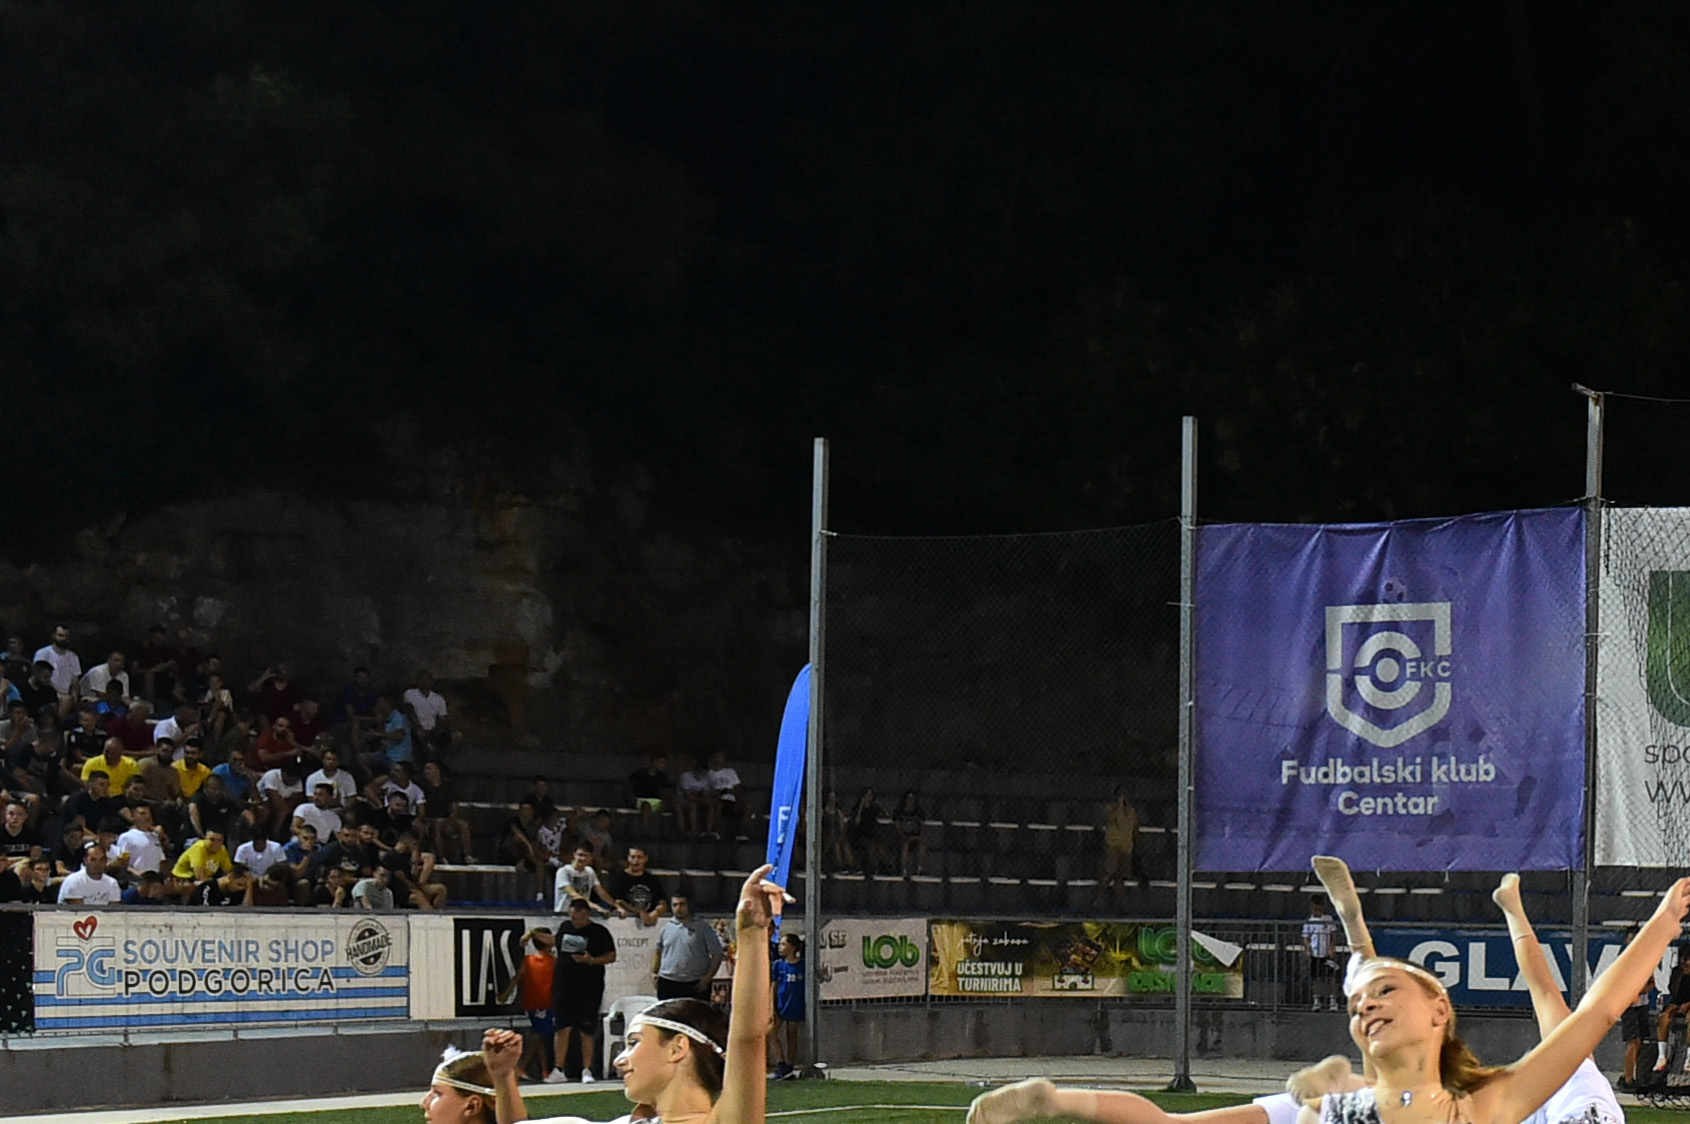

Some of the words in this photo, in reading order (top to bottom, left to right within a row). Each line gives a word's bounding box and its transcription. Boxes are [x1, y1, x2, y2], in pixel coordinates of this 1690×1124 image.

[1405, 661, 1452, 678] FKC
[1281, 756, 1422, 785] Fudbalski
[1431, 754, 1496, 784] klub
[1337, 791, 1440, 816] Centar
[122, 939, 260, 965] SOUVENIR
[267, 938, 335, 963] SHOP
[956, 959, 1013, 975] UČESTVUJ
[1014, 962, 1024, 975] U
[123, 967, 336, 996] PODGORICA
[956, 977, 1022, 993] TURNIRIMA
